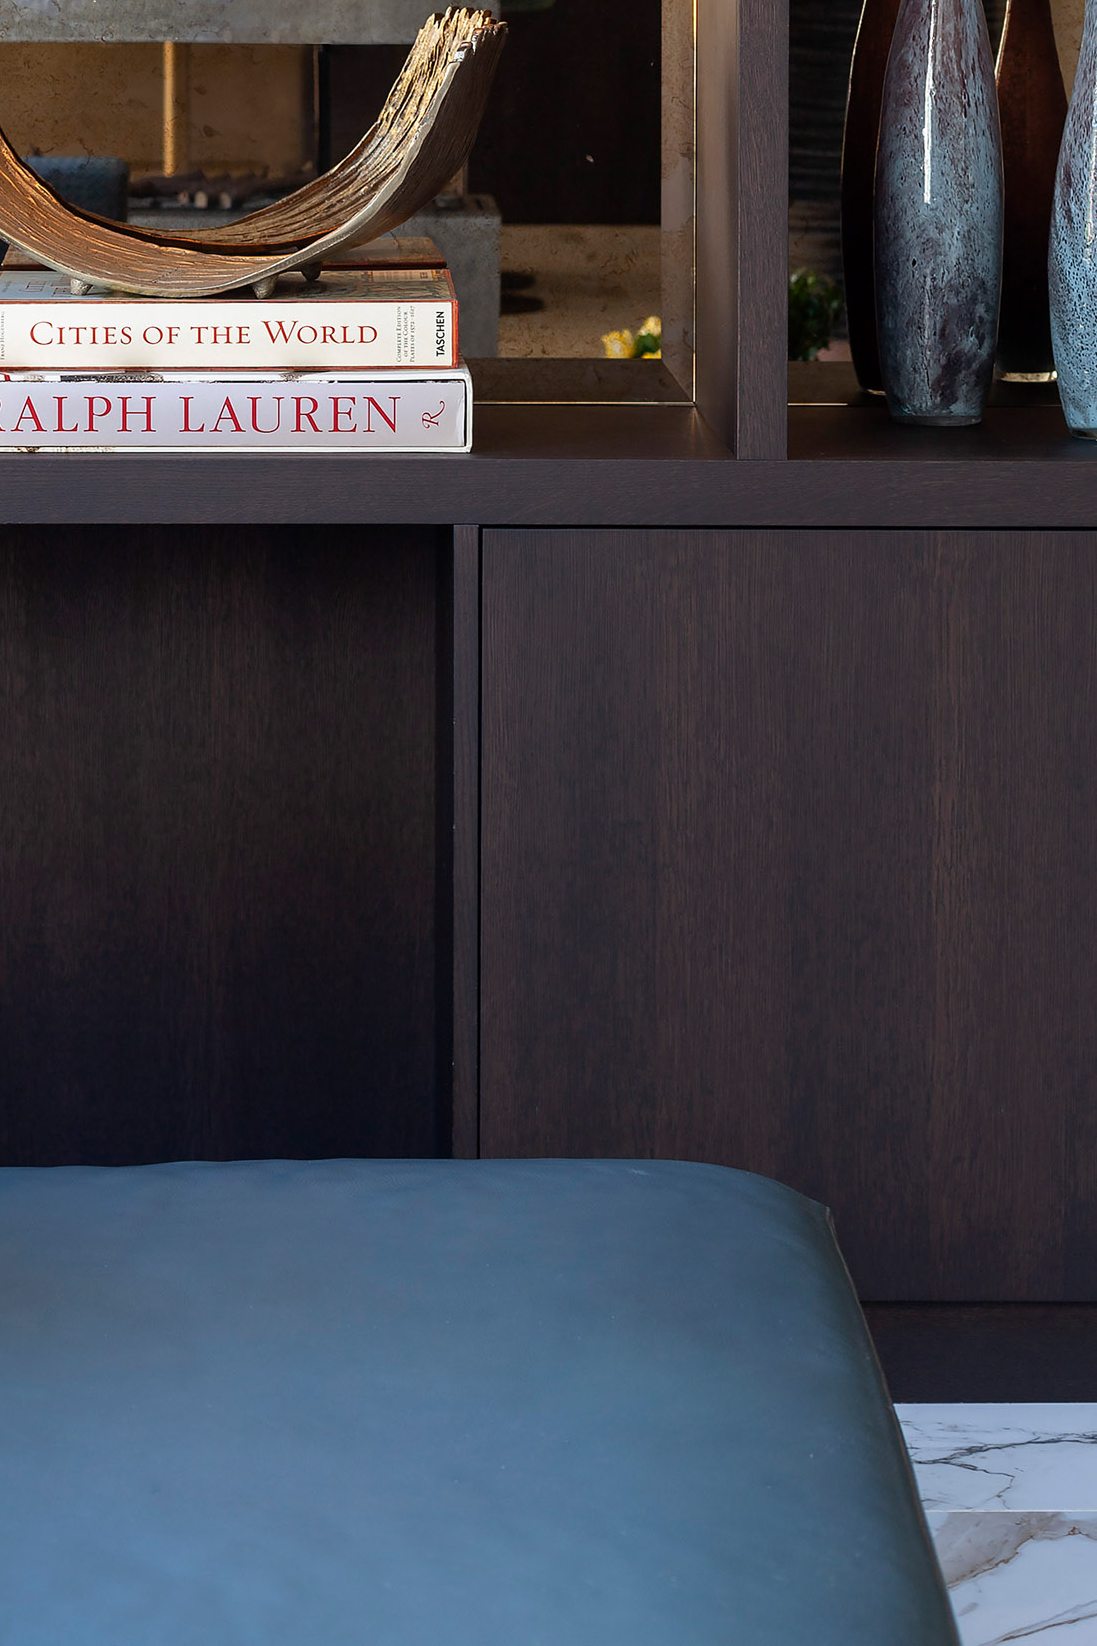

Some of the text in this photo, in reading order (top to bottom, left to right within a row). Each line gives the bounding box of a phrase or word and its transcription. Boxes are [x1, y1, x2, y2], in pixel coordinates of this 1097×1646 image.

[30, 320, 378, 346] CITIES OF THE WORLD
[435, 311, 446, 357] TASCHEN
[178, 394, 403, 433] LAUREN
